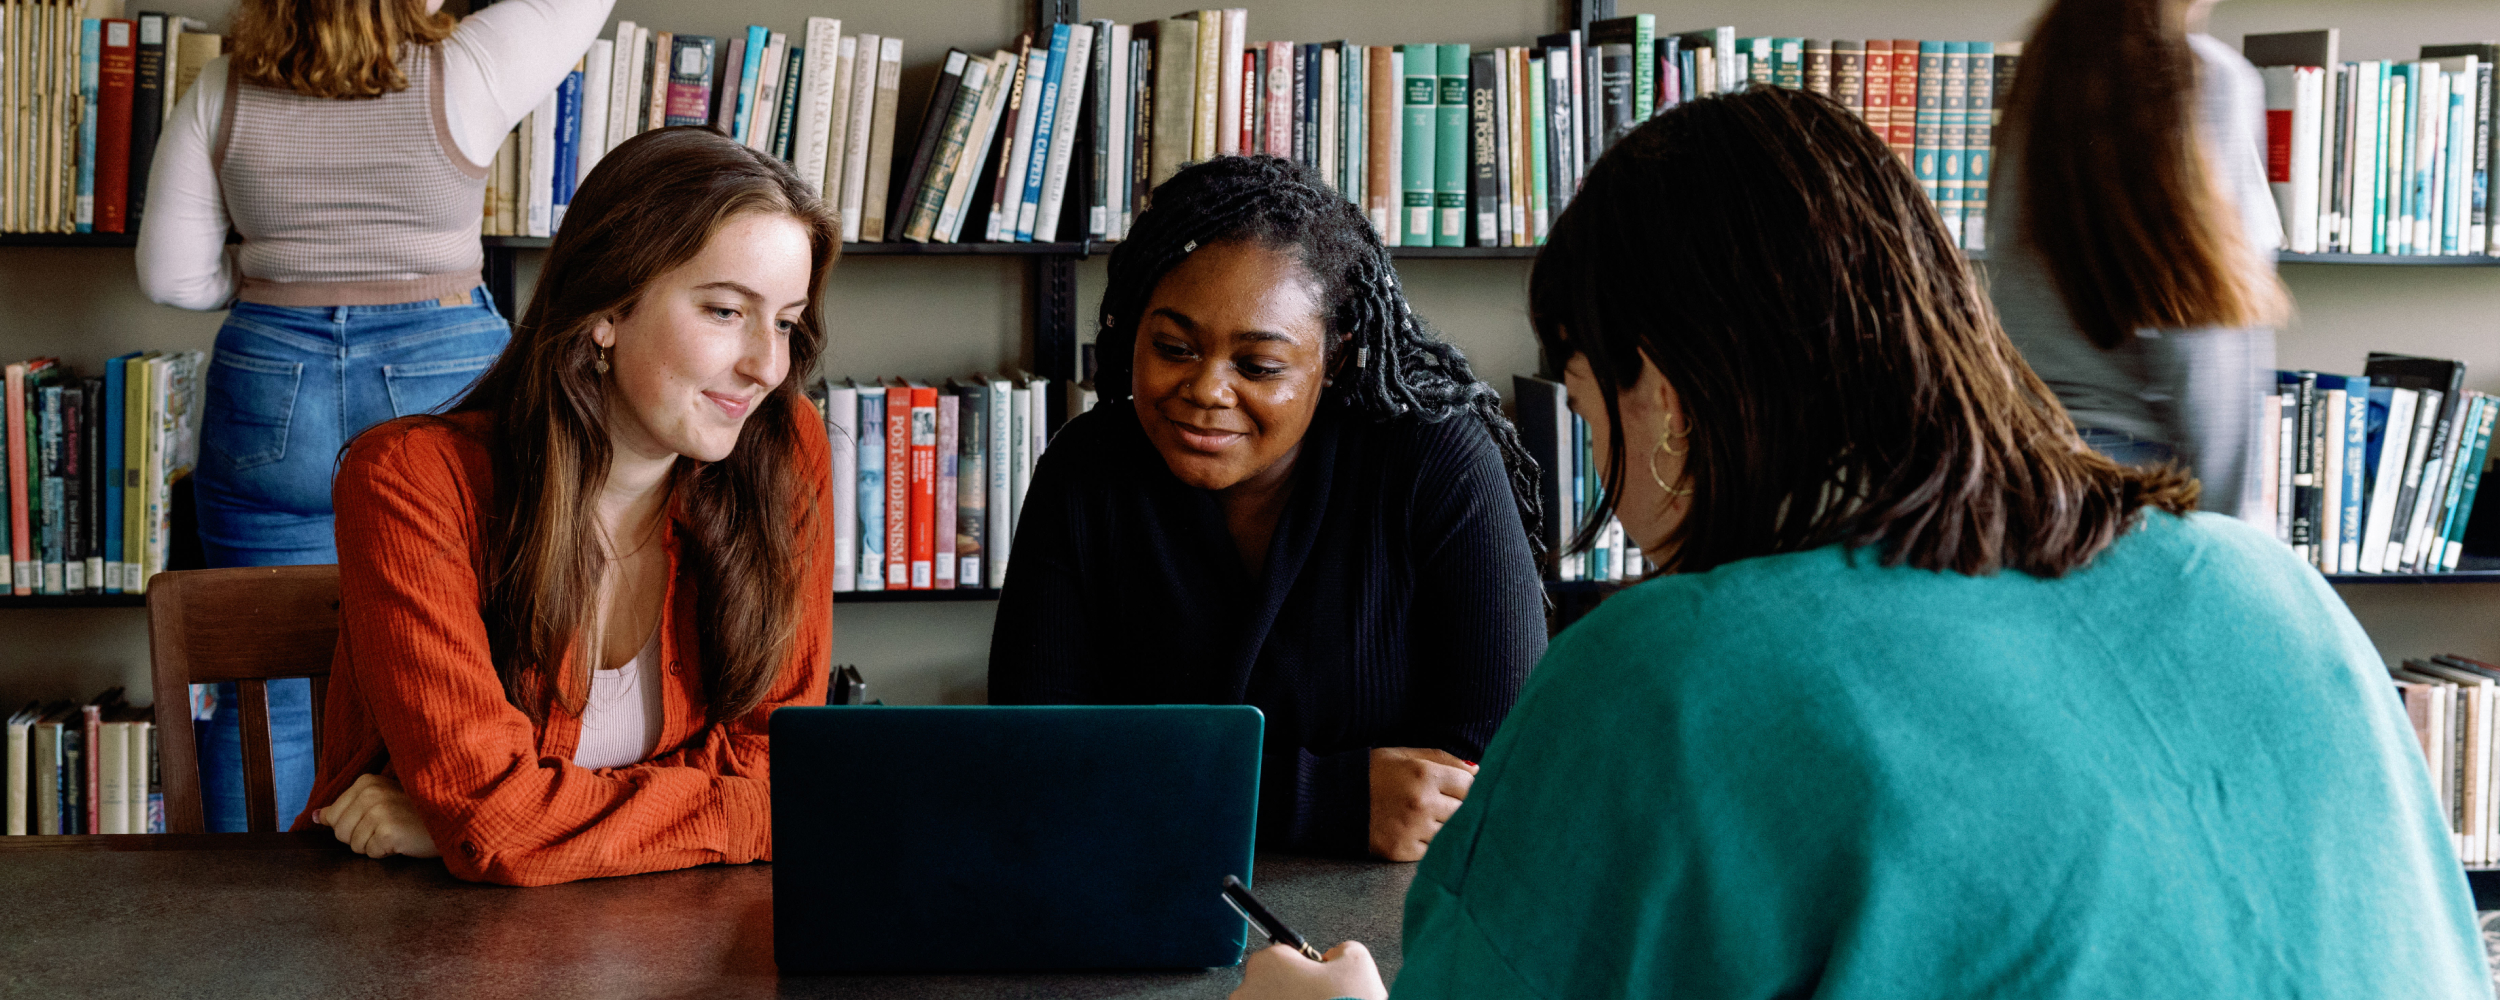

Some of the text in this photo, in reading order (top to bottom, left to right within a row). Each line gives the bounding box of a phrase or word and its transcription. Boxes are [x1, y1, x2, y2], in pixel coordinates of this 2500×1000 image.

[816, 22, 836, 96] AMERICAN
[1638, 27, 1653, 48] THE
[1295, 55, 1304, 71] TO
[1638, 52, 1653, 96] HUMAN
[849, 49, 869, 157] CROWNING GLORY
[1010, 69, 1026, 110] CLOCKS
[1244, 70, 1254, 131] SHAKESPEARE
[1295, 82, 1304, 116] YOUNG
[1474, 88, 1486, 119] COLE
[563, 114, 574, 143] Sultan
[1028, 82, 1058, 188] ORIENTAL CARPETS
[1475, 121, 1487, 166] PORTER
[995, 390, 1007, 490] BLOOMSBURY
[2299, 379, 2314, 473] World Communications
[2348, 396, 2365, 443] JANE'S
[2431, 420, 2449, 459] SPACE
[891, 415, 905, 561] POST-MODERNISM
